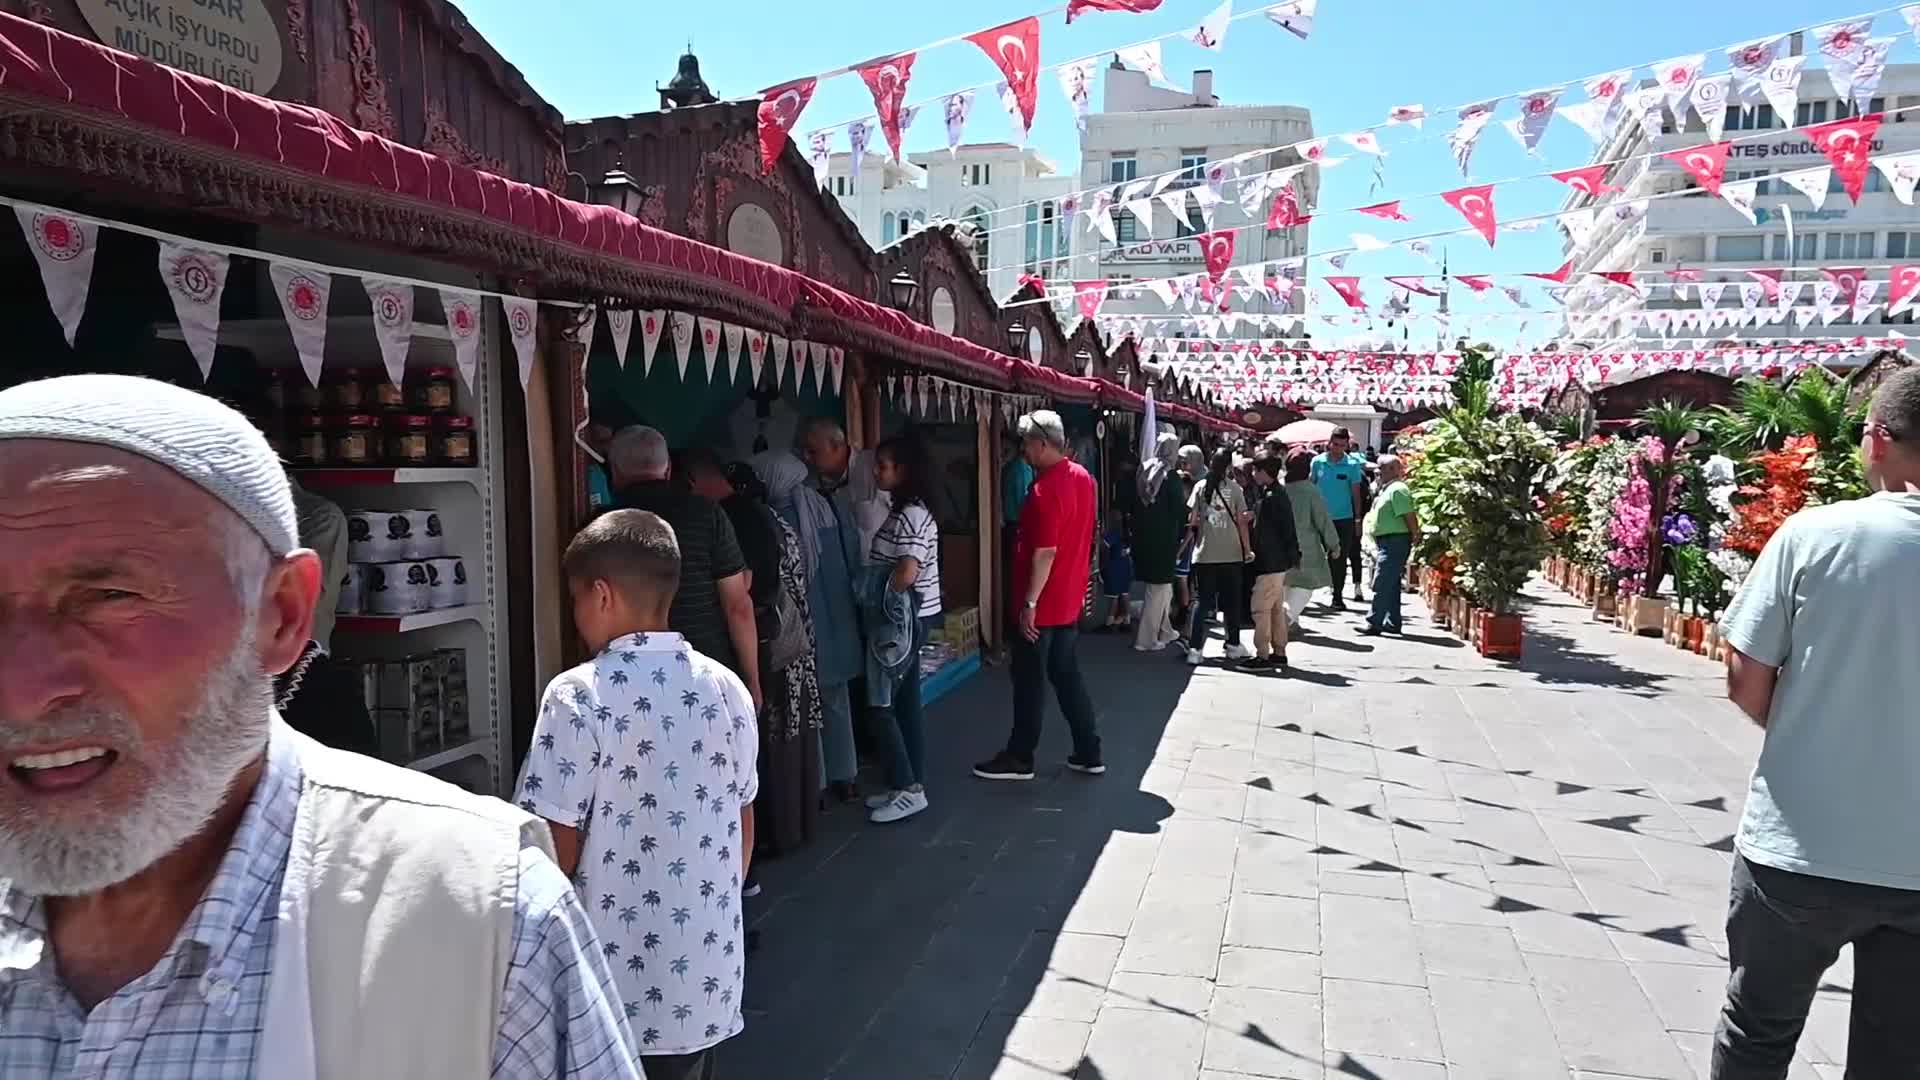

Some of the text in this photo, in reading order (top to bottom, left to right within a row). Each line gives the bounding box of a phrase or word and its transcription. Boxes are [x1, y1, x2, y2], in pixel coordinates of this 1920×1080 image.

[114, 25, 255, 93] MÜDÜRLÜĞÜ
[168, 6, 260, 64] İŞYURDU
[1156, 243, 1190, 254] YAPI
